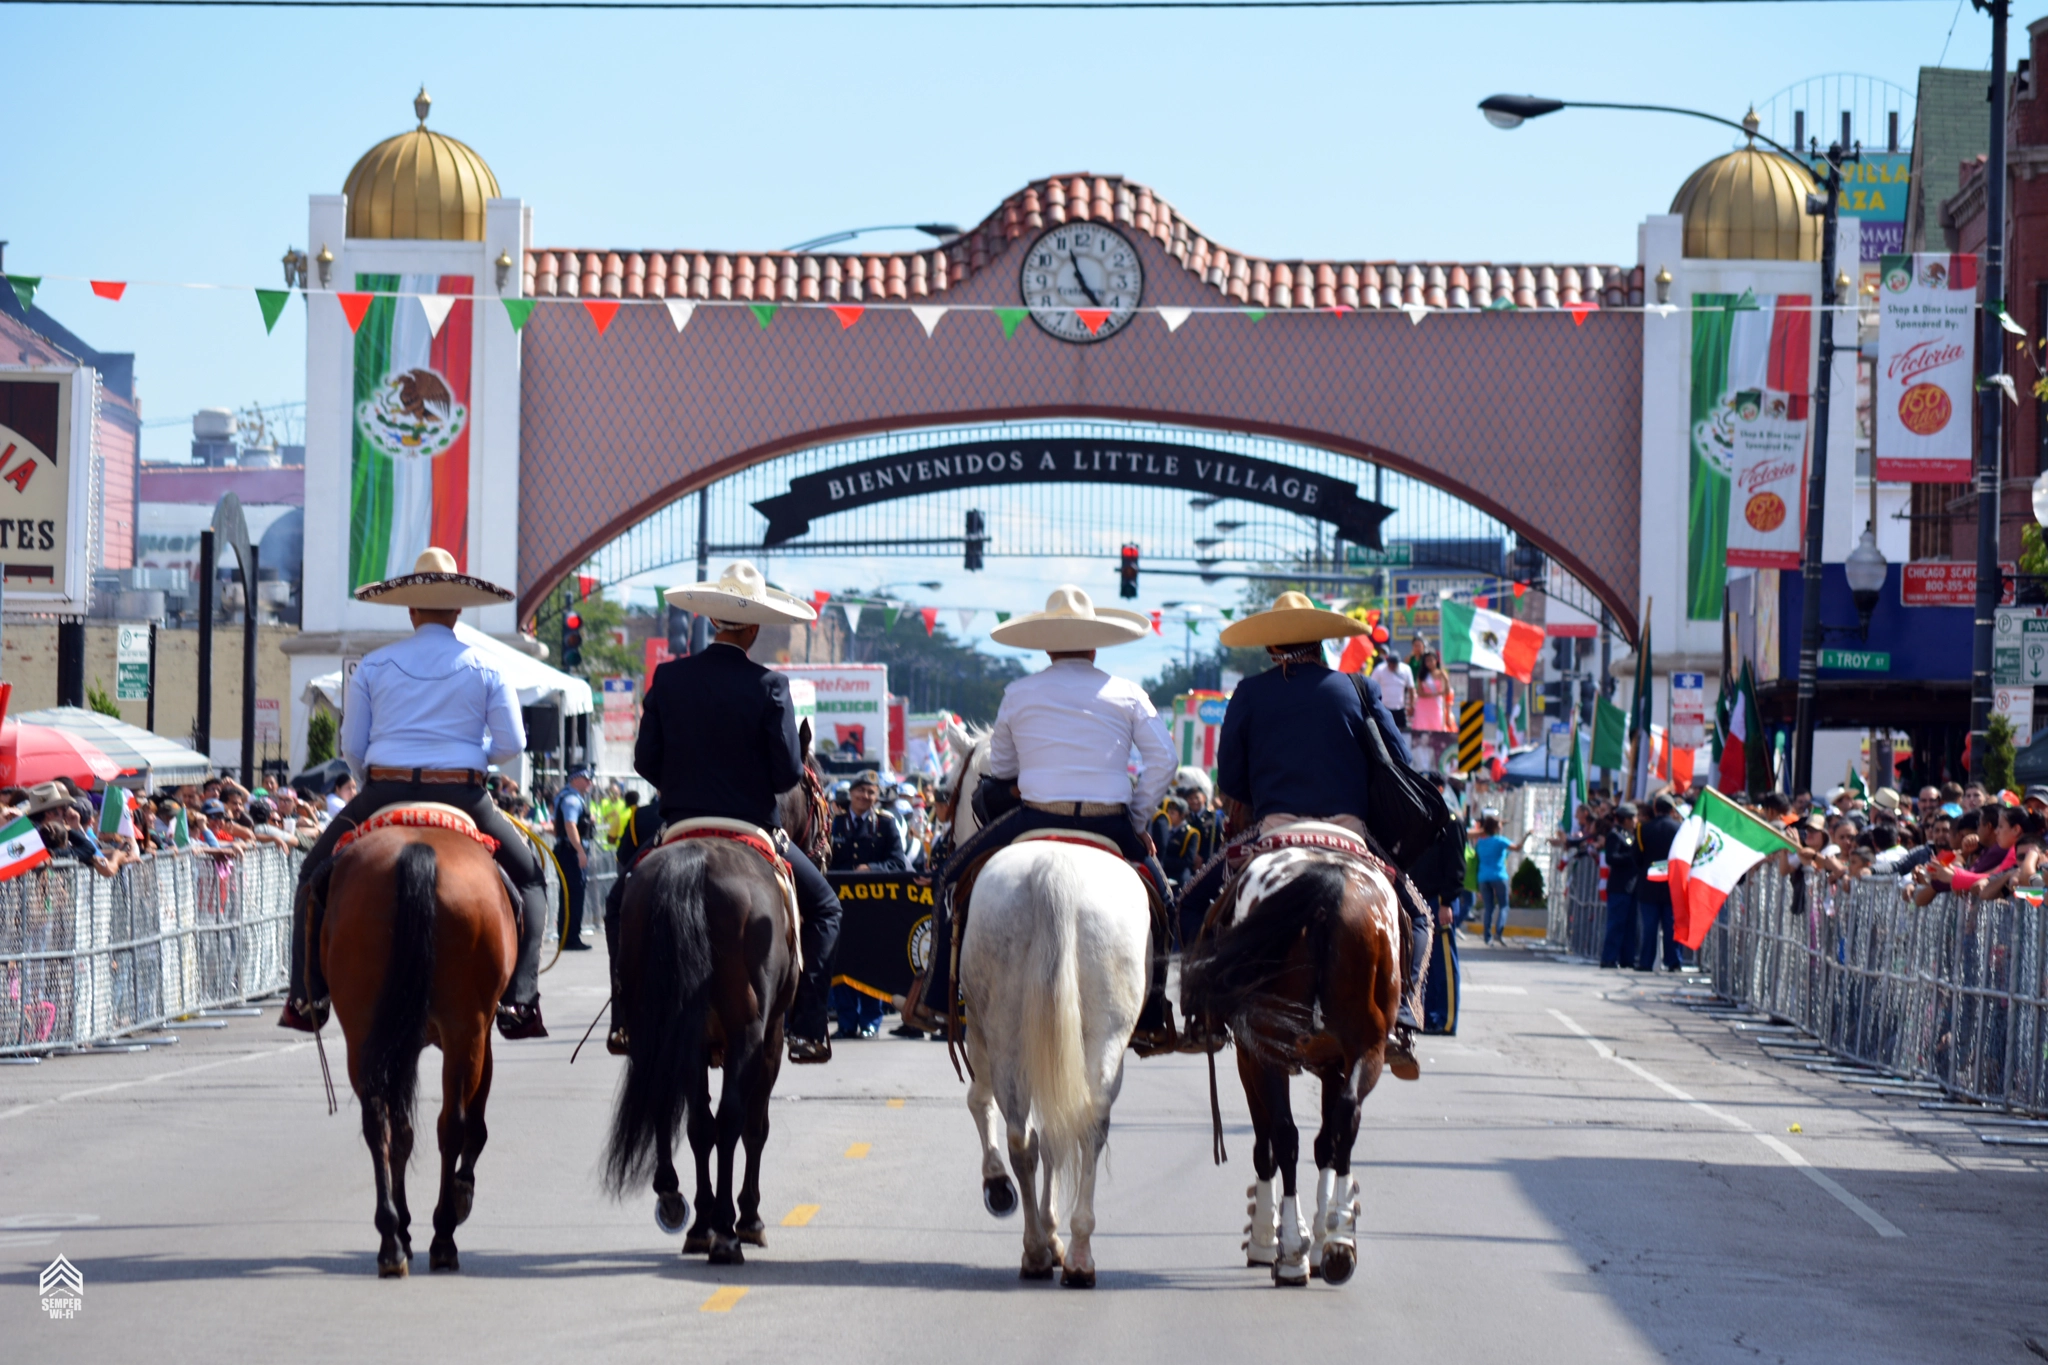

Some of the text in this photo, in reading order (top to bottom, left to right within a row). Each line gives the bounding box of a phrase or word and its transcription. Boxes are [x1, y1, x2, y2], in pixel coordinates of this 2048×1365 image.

[1838, 190, 1886, 211] AZA
[1075, 232, 1090, 248] 12
[1860, 226, 1903, 243] MMU
[1057, 236, 1067, 251] 11
[1101, 239, 1106, 252] 1
[1039, 253, 1052, 267] 10
[1113, 253, 1125, 268] 2
[1036, 274, 1048, 290] 9
[1117, 274, 1128, 290] 3
[1041, 295, 1052, 308] 8
[1109, 295, 1119, 308] 4
[1888, 304, 1968, 316] Shop & Dine Local
[1056, 312, 1066, 327] 7
[1895, 319, 1960, 331] Sponsored By:
[1887, 336, 1965, 387] Victoria
[1900, 386, 1942, 414] 150
[828, 450, 1319, 504] BIENVENIDOS A LITTLE VILLAGE
[1738, 455, 1798, 494] Victoria
[0, 518, 55, 551] TES
[1907, 566, 1946, 579] CHICAGO
[2028, 621, 2048, 633] PAY
[1837, 651, 1871, 669] TROY
[834, 677, 871, 692] Farm
[838, 883, 934, 906] AGUT CA
